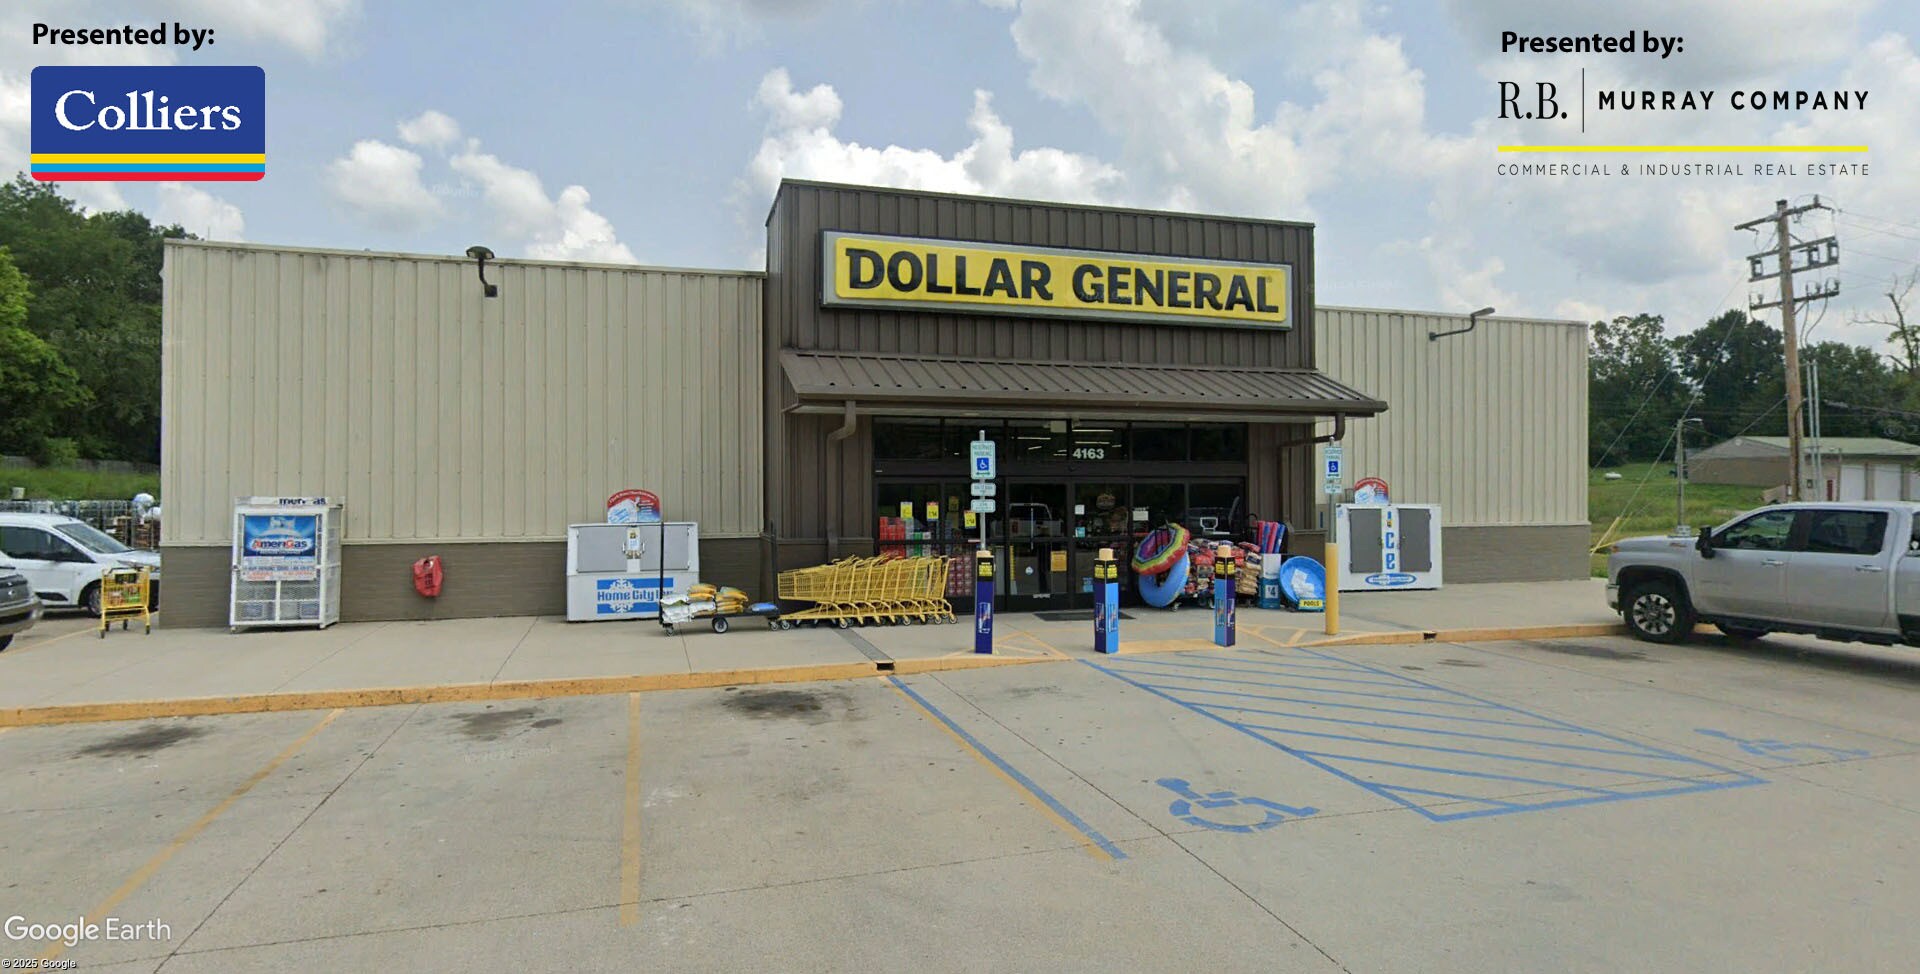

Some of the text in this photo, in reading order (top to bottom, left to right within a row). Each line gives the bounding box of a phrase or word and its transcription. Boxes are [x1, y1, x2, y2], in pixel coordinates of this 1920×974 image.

[845, 247, 1279, 313] DOLLAR GENERAL
[1072, 448, 1105, 460] 4163
[251, 539, 307, 549] AmeriGas
[597, 591, 631, 601] Home
[632, 589, 655, 601] City
